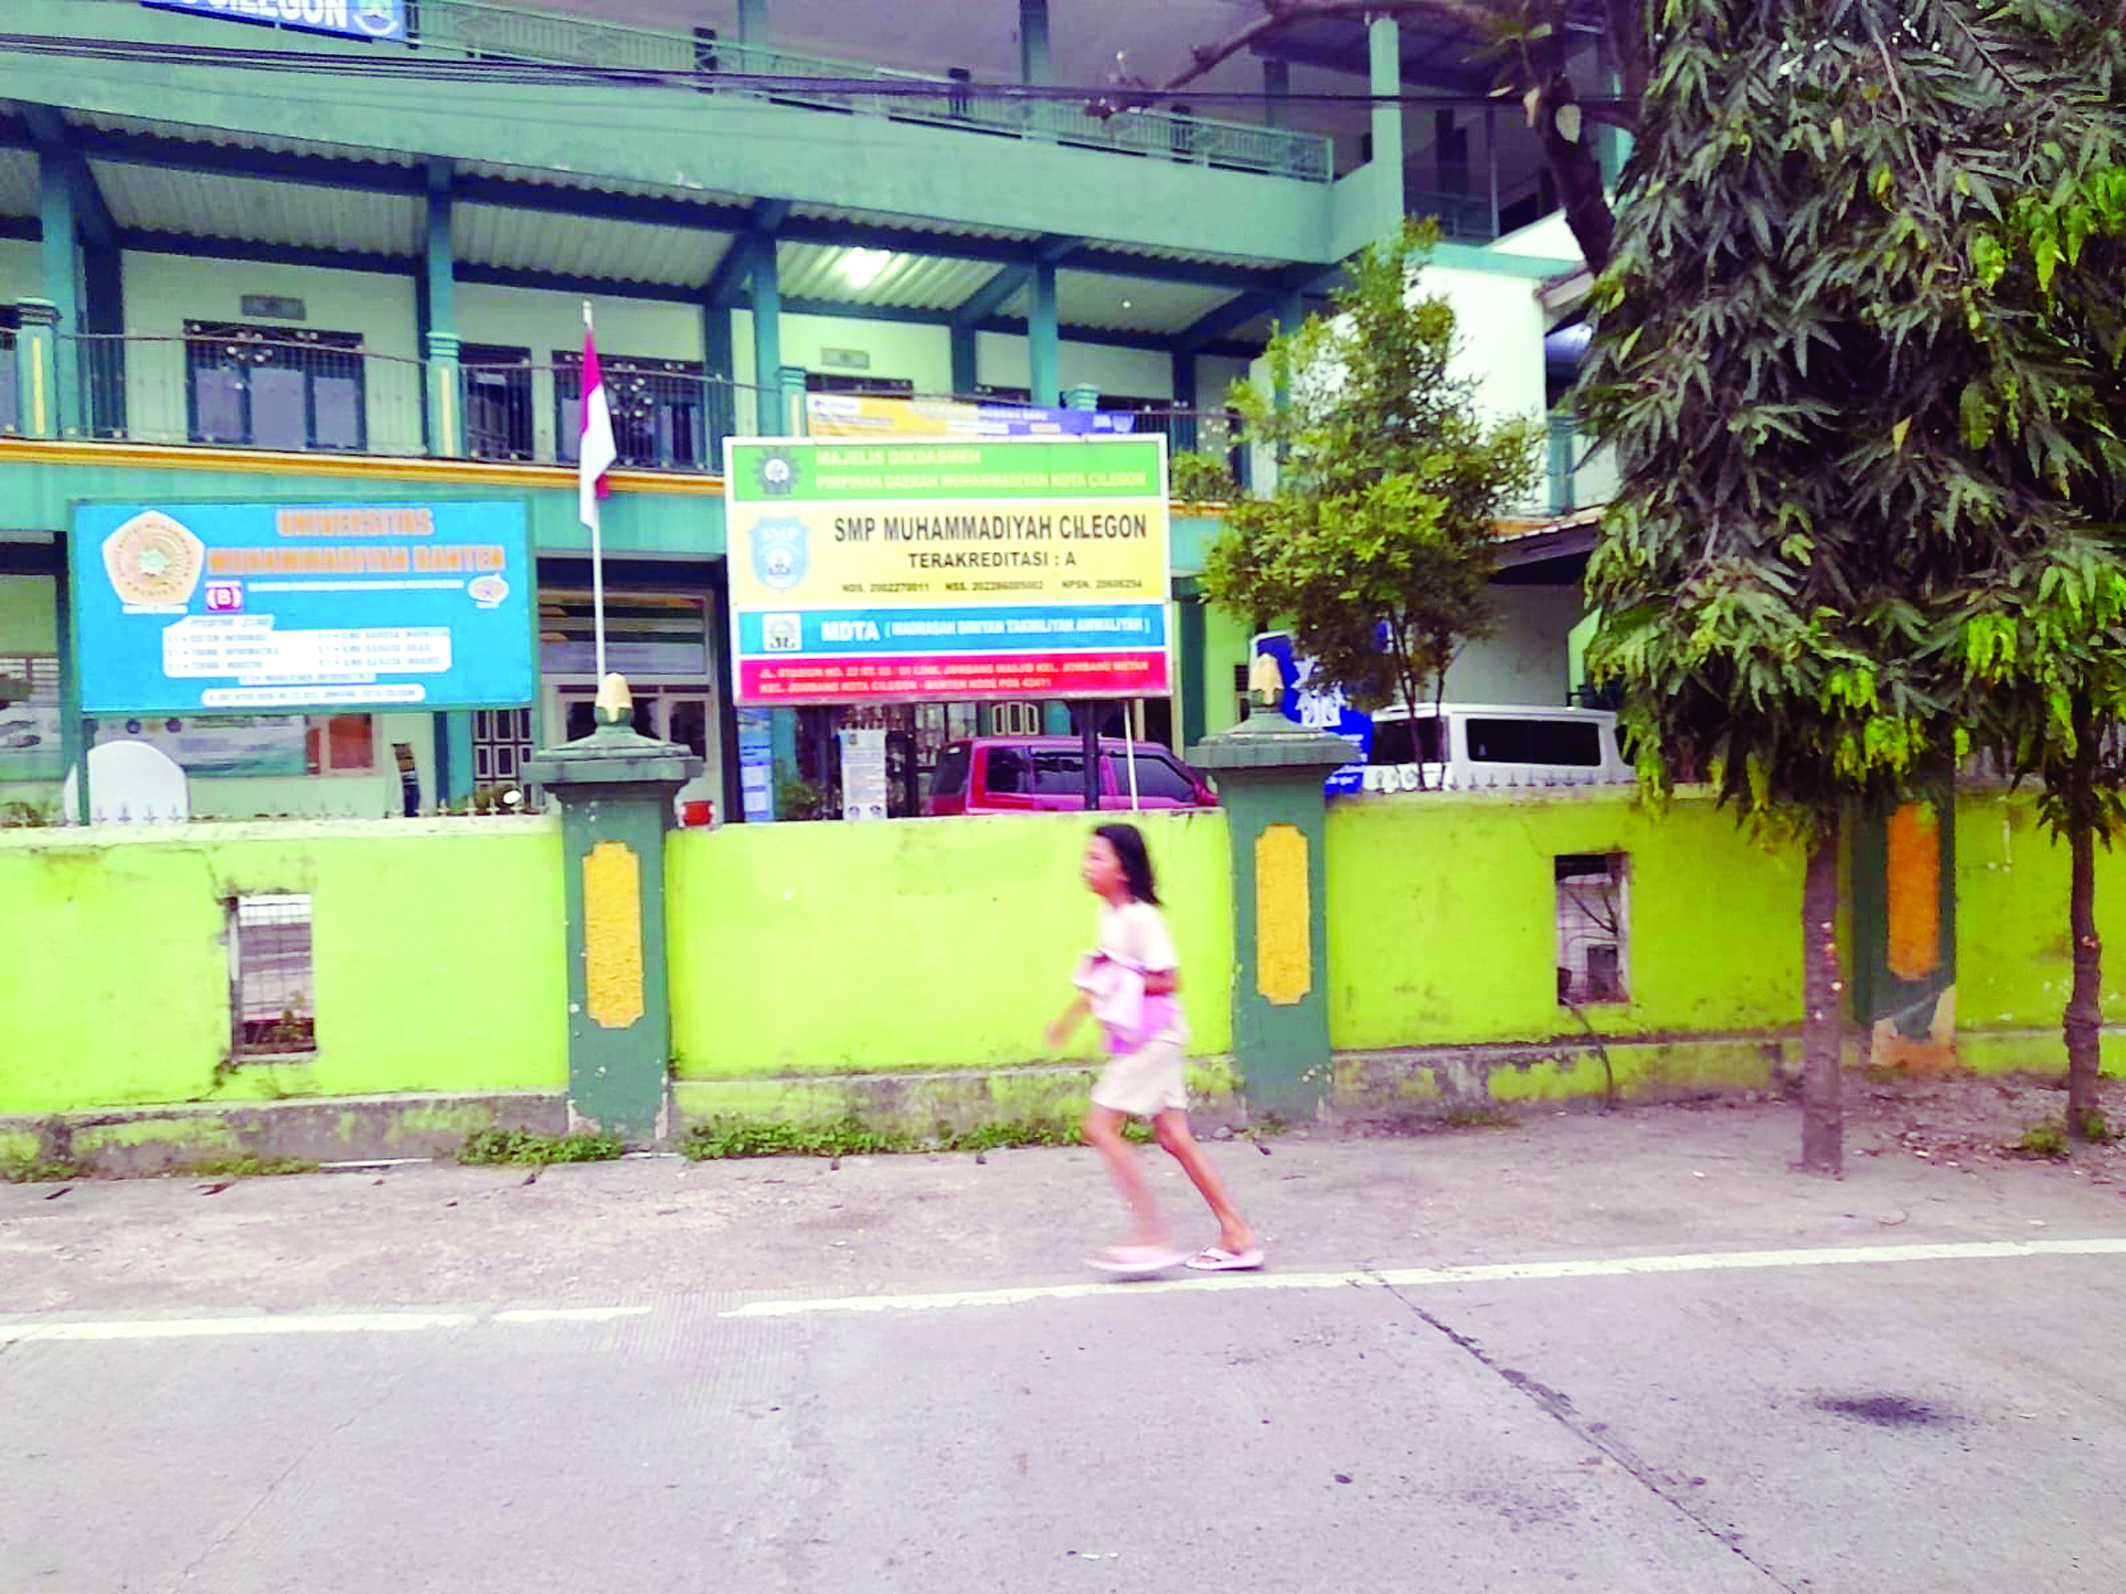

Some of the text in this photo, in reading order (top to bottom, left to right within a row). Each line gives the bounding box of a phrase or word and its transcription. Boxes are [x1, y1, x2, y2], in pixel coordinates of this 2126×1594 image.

[816, 449, 980, 466] MAJELIS DIKDASMEN
[816, 471, 1147, 489] PIMPINAN DAERAH MUHAMMADIYAH KOTA CILEGON
[834, 513, 1147, 542] SMP MUHAMMADIYAH CILEGON
[908, 551, 1049, 569] TERAKREDITASI
[1065, 551, 1077, 567] A
[821, 620, 881, 642] MDTA
